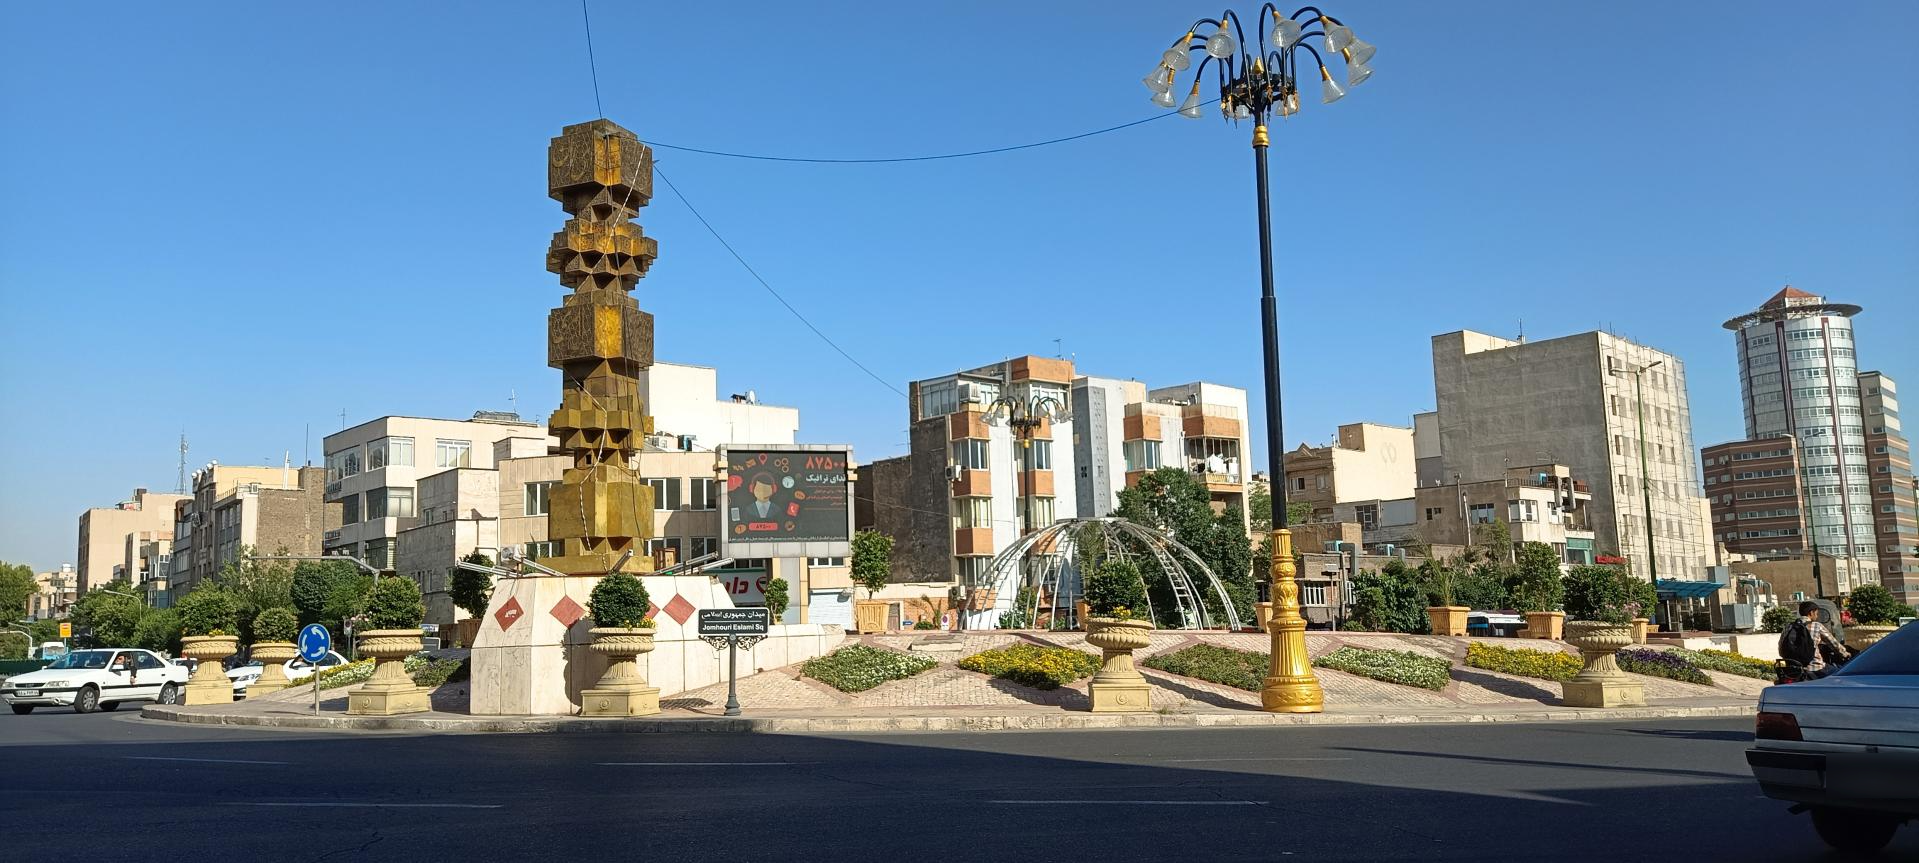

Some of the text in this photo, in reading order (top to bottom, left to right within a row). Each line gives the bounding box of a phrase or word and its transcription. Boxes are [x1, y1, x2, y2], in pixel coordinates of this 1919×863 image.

[806, 456, 845, 470] ۸۷۵۰۰
[805, 472, 846, 484] ندای ترافیک
[701, 611, 765, 619] میدان جمهوری اسلامی
[755, 623, 764, 631] Sq
